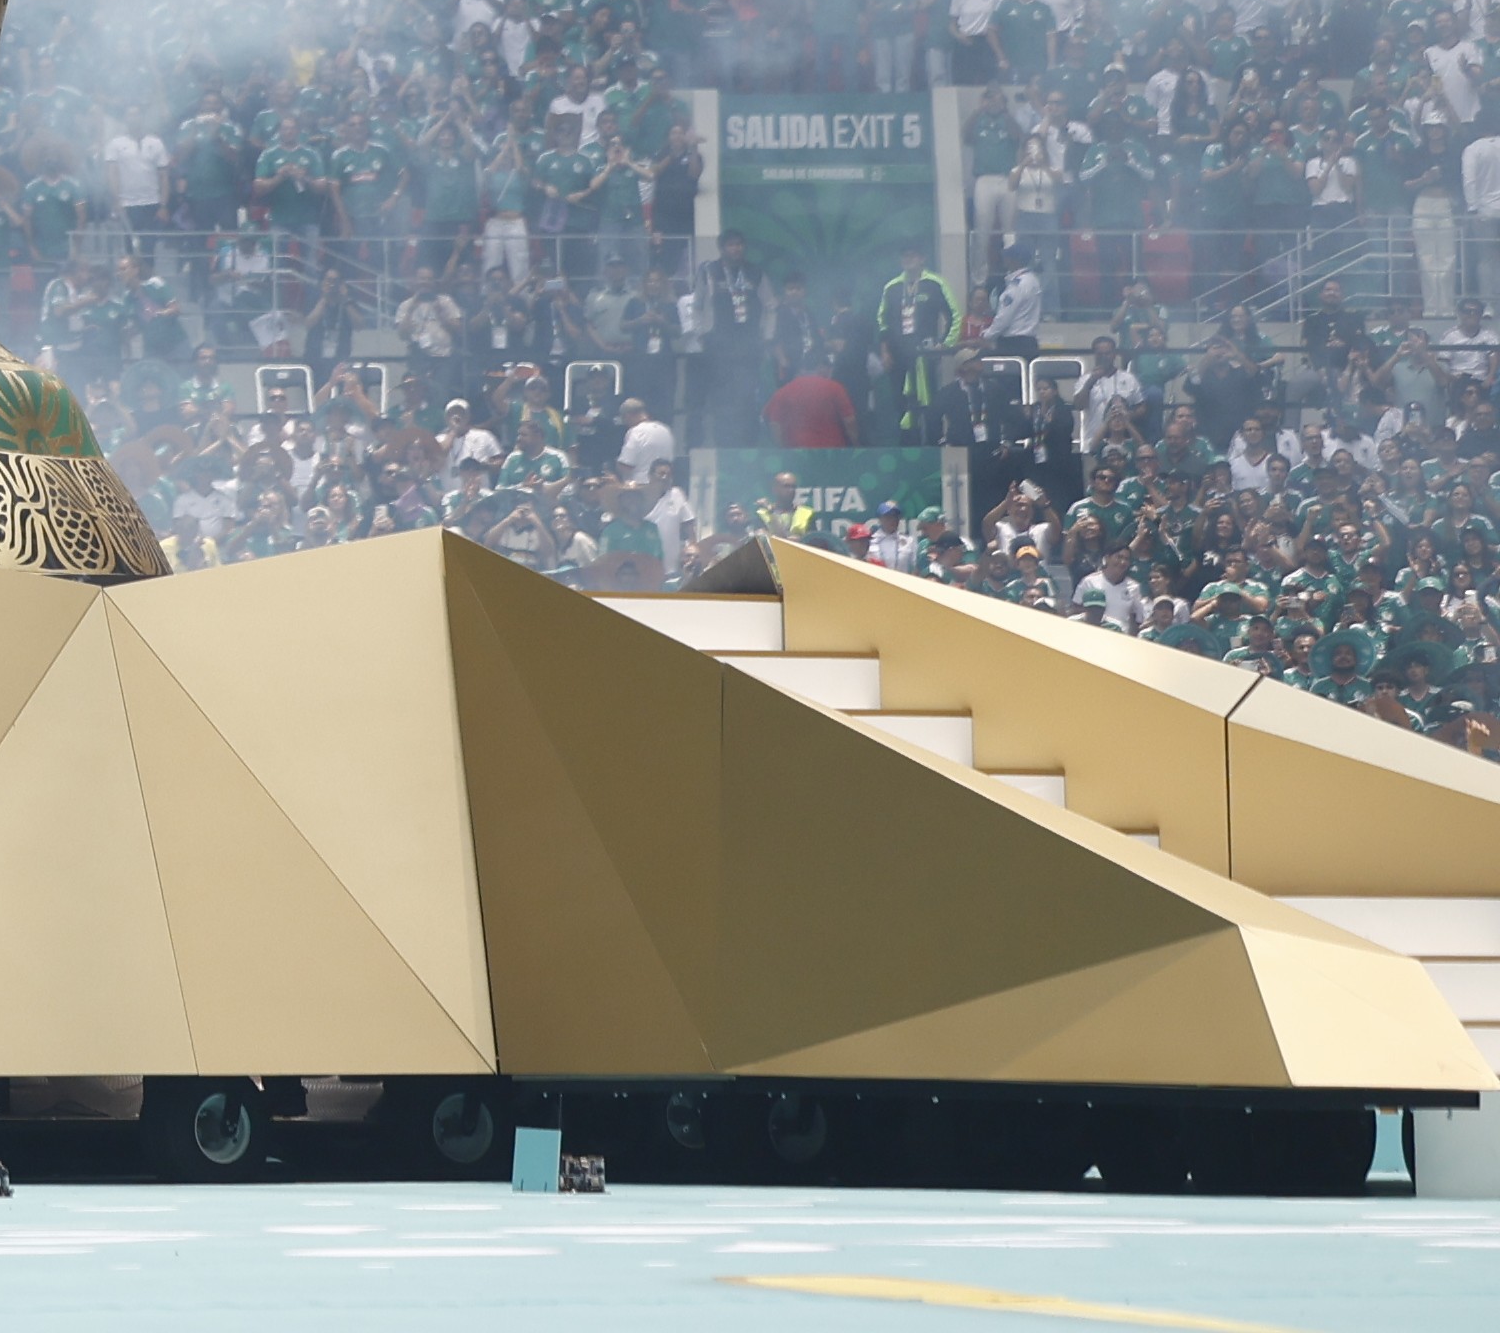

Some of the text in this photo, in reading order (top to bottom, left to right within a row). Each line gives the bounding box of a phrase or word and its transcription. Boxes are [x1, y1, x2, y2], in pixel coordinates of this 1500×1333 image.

[726, 113, 922, 150] SALIDA EXIT 5
[792, 486, 867, 512] FIFA
